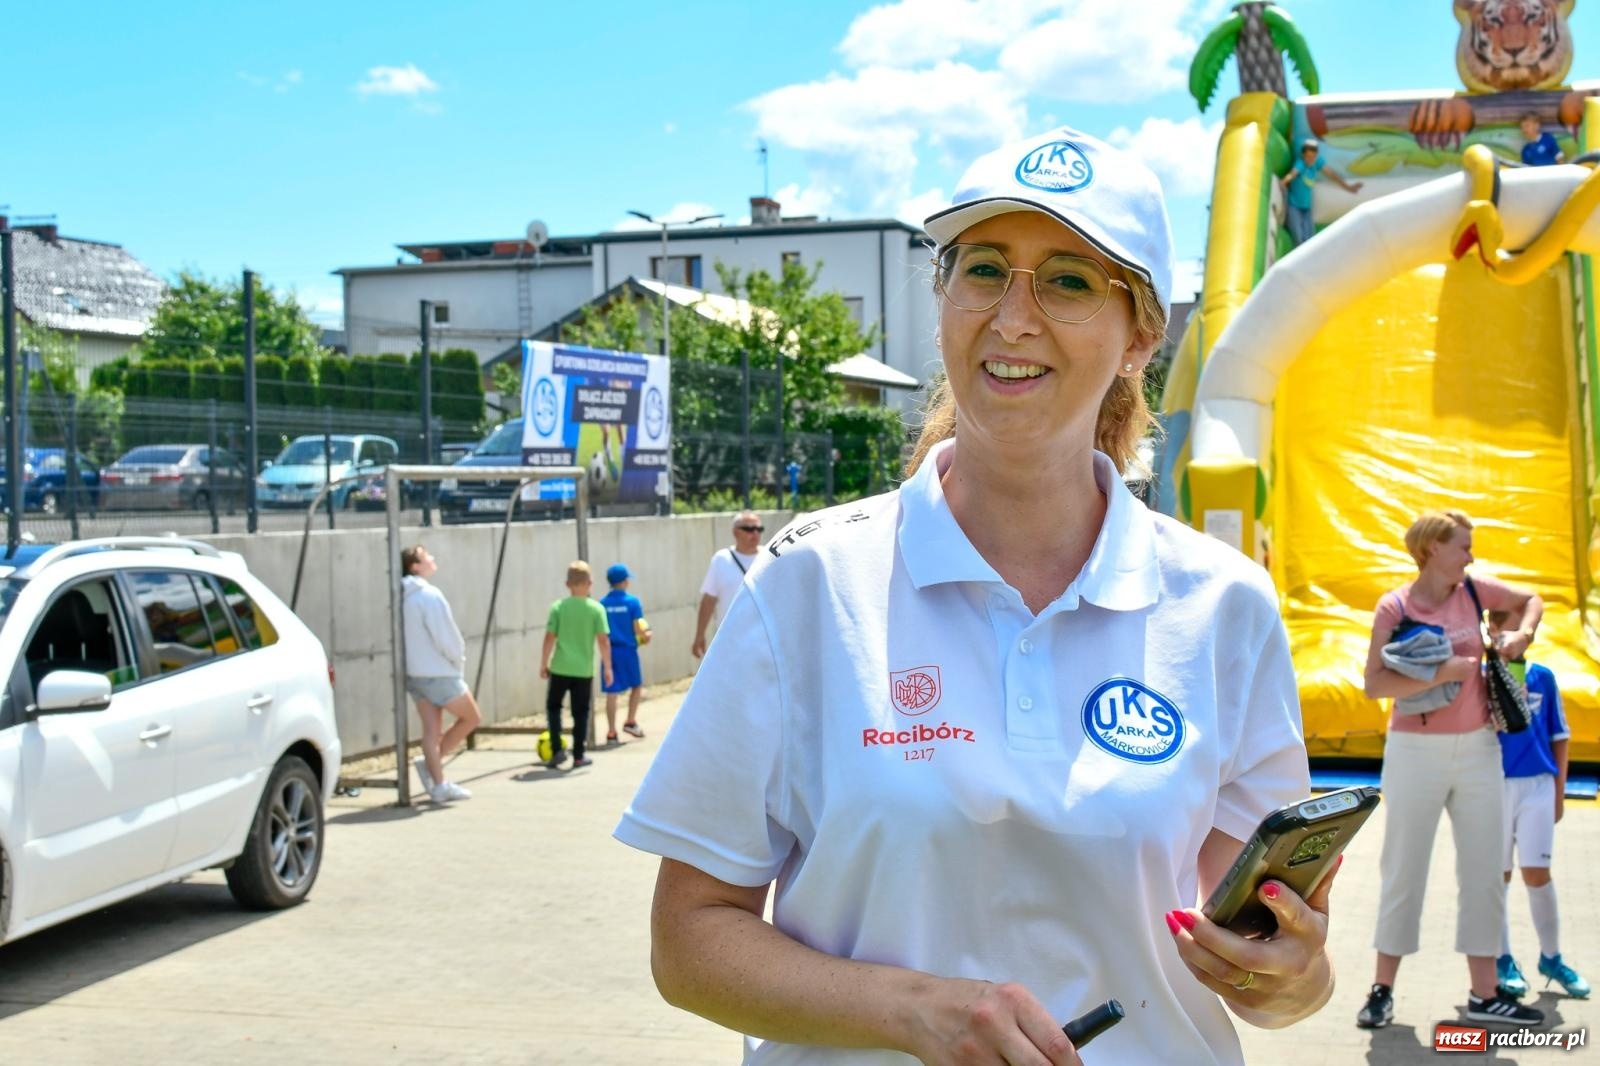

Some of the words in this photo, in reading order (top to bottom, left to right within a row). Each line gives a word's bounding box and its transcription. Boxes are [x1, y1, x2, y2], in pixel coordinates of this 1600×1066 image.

[1023, 145, 1086, 180] UKS
[1094, 686, 1174, 737] UKS
[863, 721, 975, 747] Racibórz
[1100, 731, 1171, 755] MARKOWICE
[1116, 725, 1156, 739] ARKA
[904, 747, 935, 761] 1217
